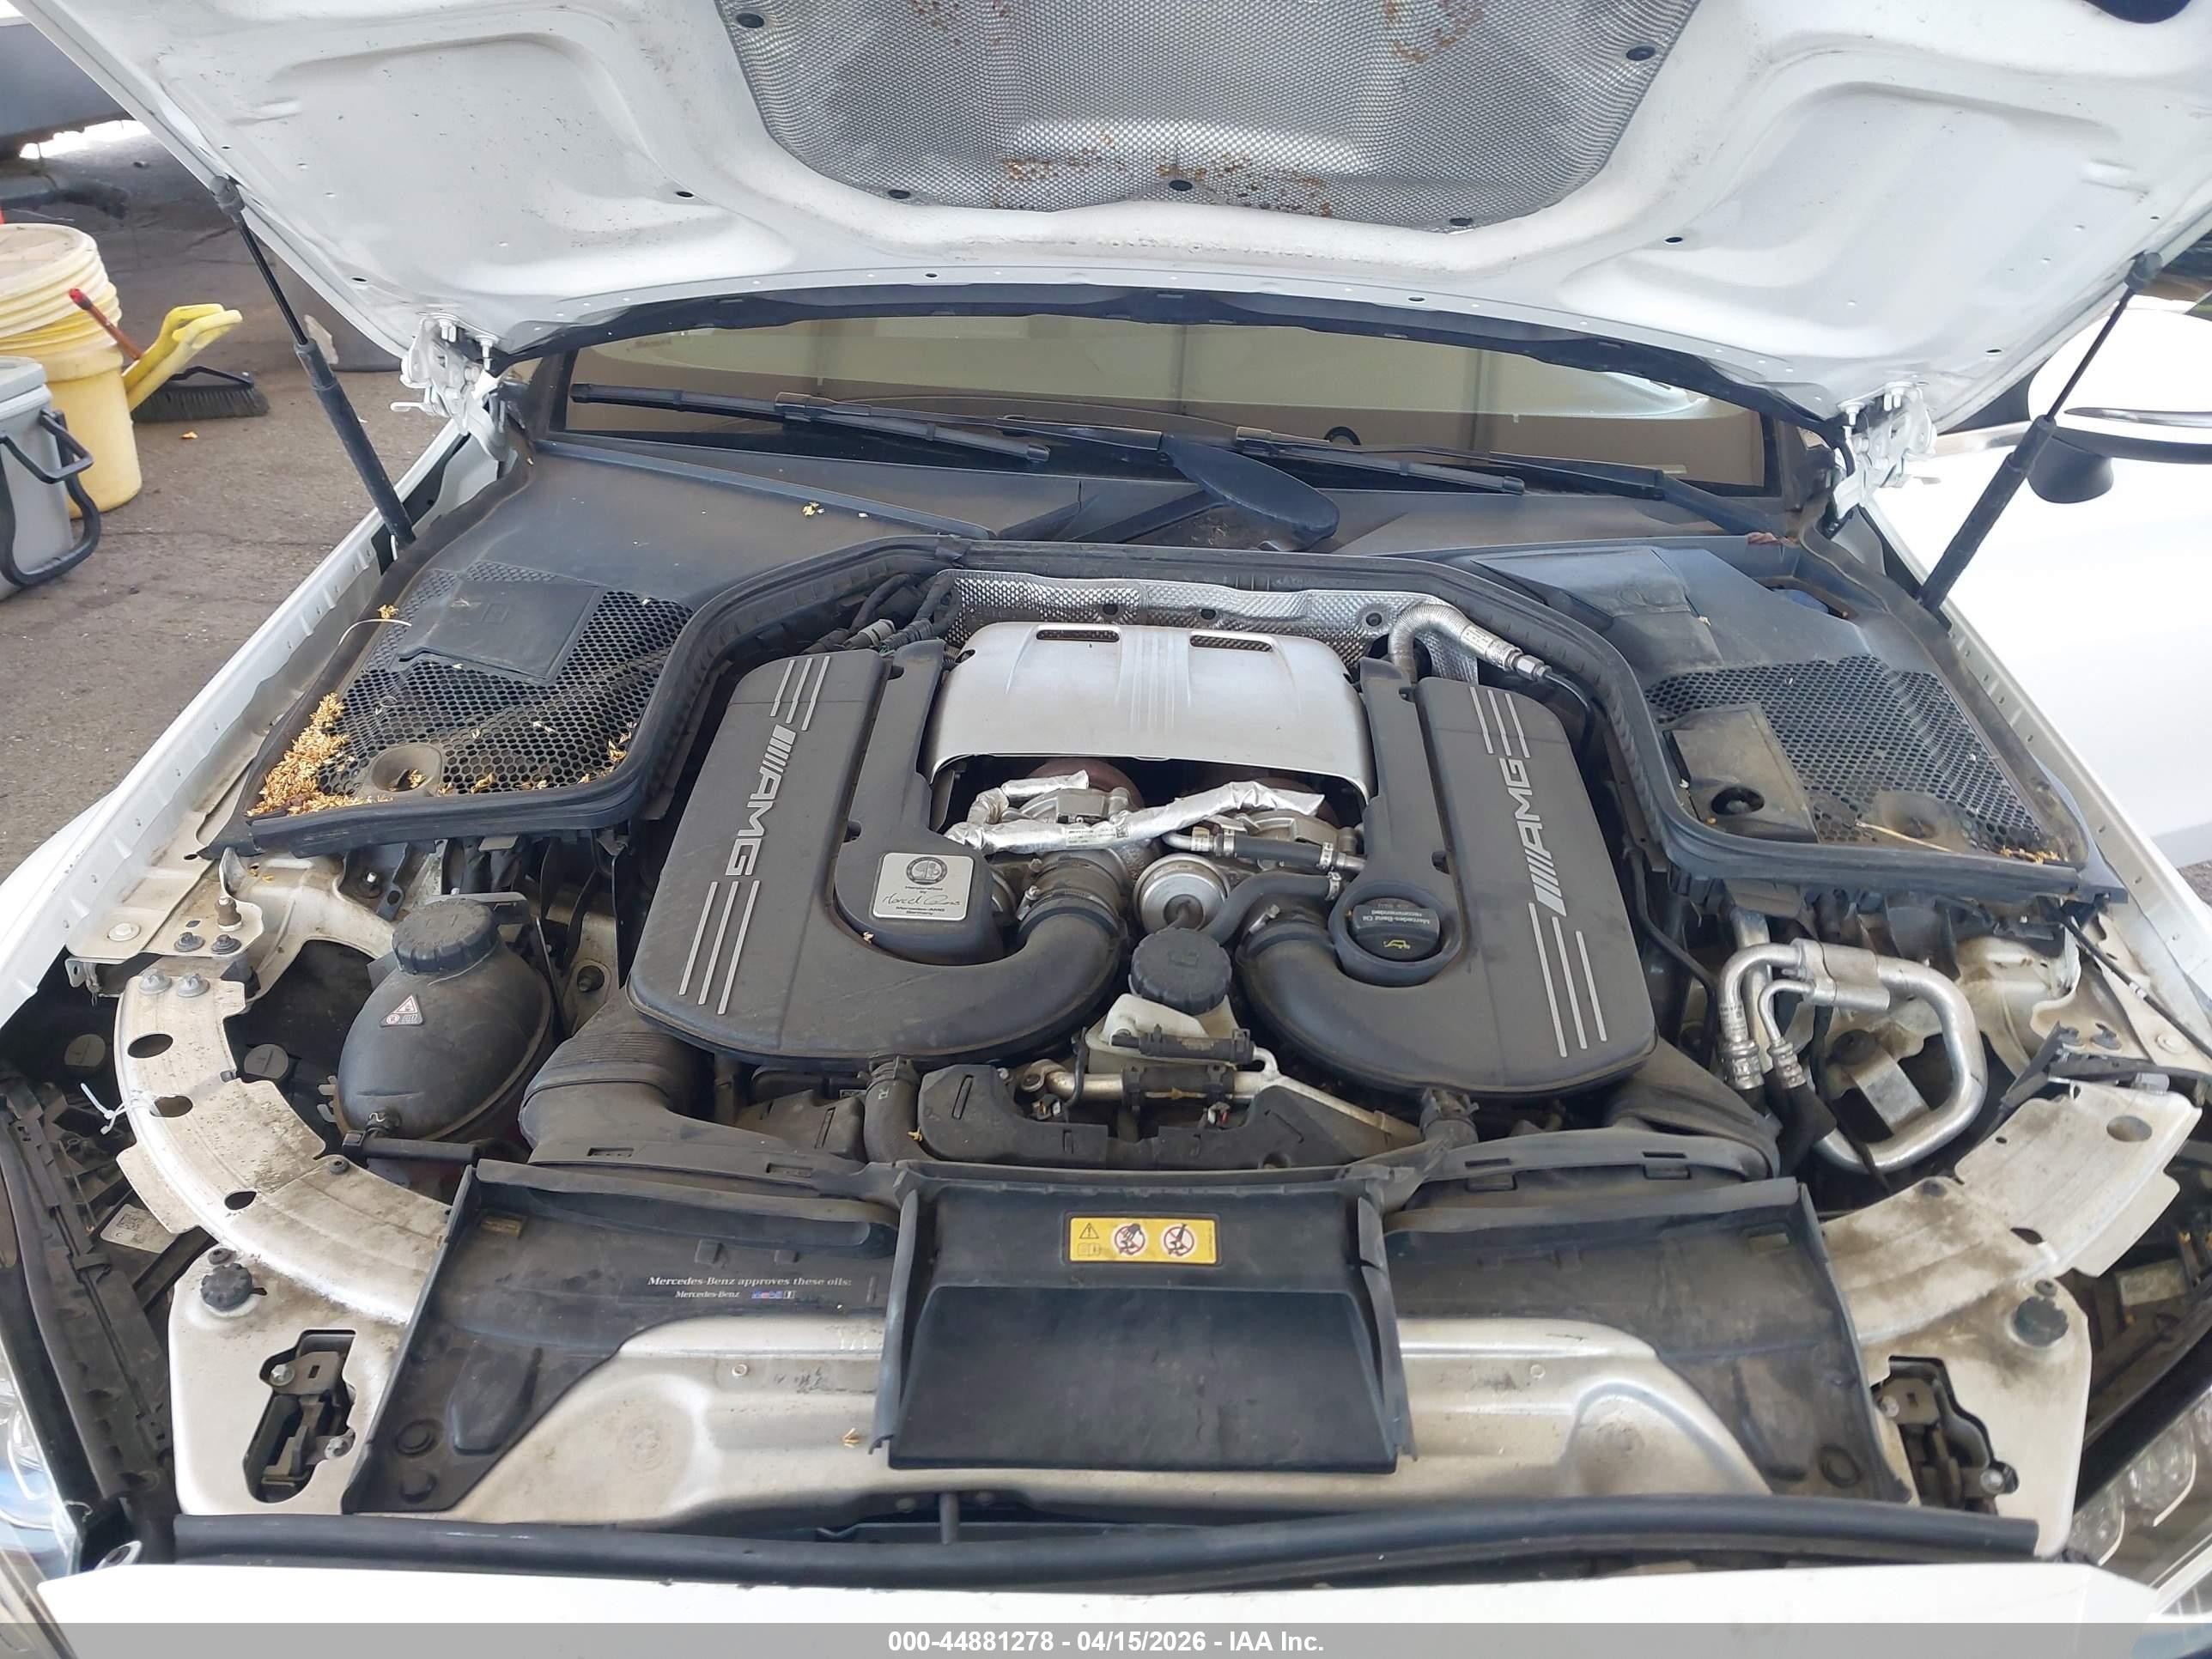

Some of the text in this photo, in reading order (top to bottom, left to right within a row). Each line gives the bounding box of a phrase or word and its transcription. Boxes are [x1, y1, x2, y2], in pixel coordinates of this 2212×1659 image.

[1498, 757, 1553, 860] AMG
[725, 766, 781, 875] AMG
[1374, 915, 1431, 925] Mercedes-Benz
[647, 1276, 852, 1287] Mercedes-Benz approves these oils:
[674, 1290, 740, 1299] Mercedes-Benz
